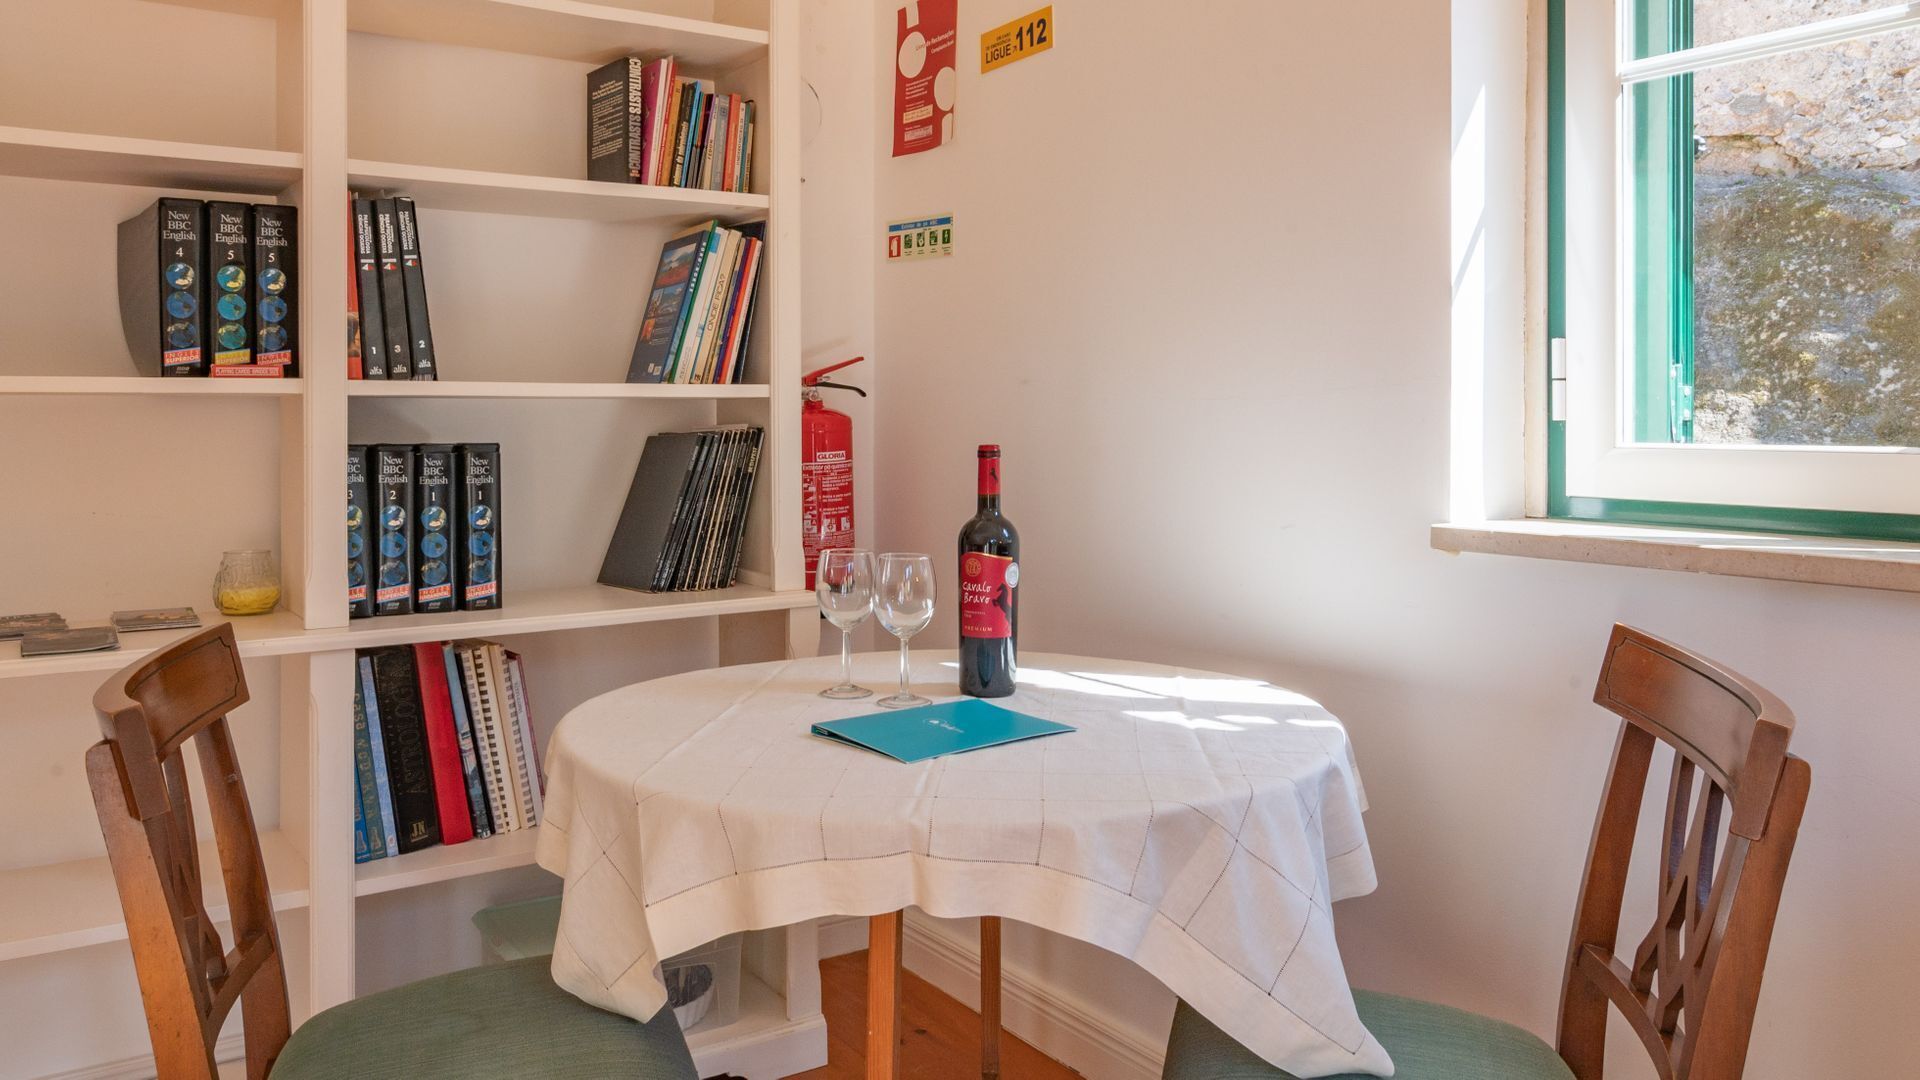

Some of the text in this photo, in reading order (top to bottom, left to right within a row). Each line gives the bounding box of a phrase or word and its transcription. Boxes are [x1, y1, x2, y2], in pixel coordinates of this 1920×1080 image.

[1015, 18, 1047, 51] 112
[985, 43, 1011, 64] LIGUE
[629, 58, 642, 114] CONTRASTS
[629, 114, 642, 170] CONTRASTS
[168, 211, 190, 220] New
[221, 214, 242, 224] New
[168, 220, 191, 230] BBC
[261, 218, 282, 227] New
[220, 224, 243, 234] BBC
[261, 227, 284, 237] BBC
[163, 231, 196, 242] English
[215, 234, 248, 245] English
[256, 236, 288, 248] English
[176, 247, 184, 257] 4
[227, 251, 235, 260] 5
[268, 253, 275, 263] 5
[707, 273, 726, 331] ONDE FICA?
[418, 340, 426, 348] 2
[371, 347, 377, 355] 1
[394, 345, 401, 353] 3
[418, 359, 431, 368] alfa
[369, 366, 383, 375] alfa
[393, 364, 407, 374] alfa
[384, 456, 402, 464] New
[817, 452, 845, 460] GLORIA
[424, 458, 443, 466] New
[471, 458, 489, 466] New
[348, 465, 360, 473] BC
[383, 465, 404, 474] BBC
[423, 467, 444, 476] BBC
[470, 466, 490, 475] BBC
[348, 475, 364, 484] glish
[378, 475, 408, 485] English
[419, 476, 448, 486] English
[466, 475, 494, 486] English
[348, 490, 354, 499] 3
[389, 491, 397, 500] 2
[432, 492, 436, 501] 1
[478, 491, 482, 500] 1
[963, 592, 991, 604] Bravo
